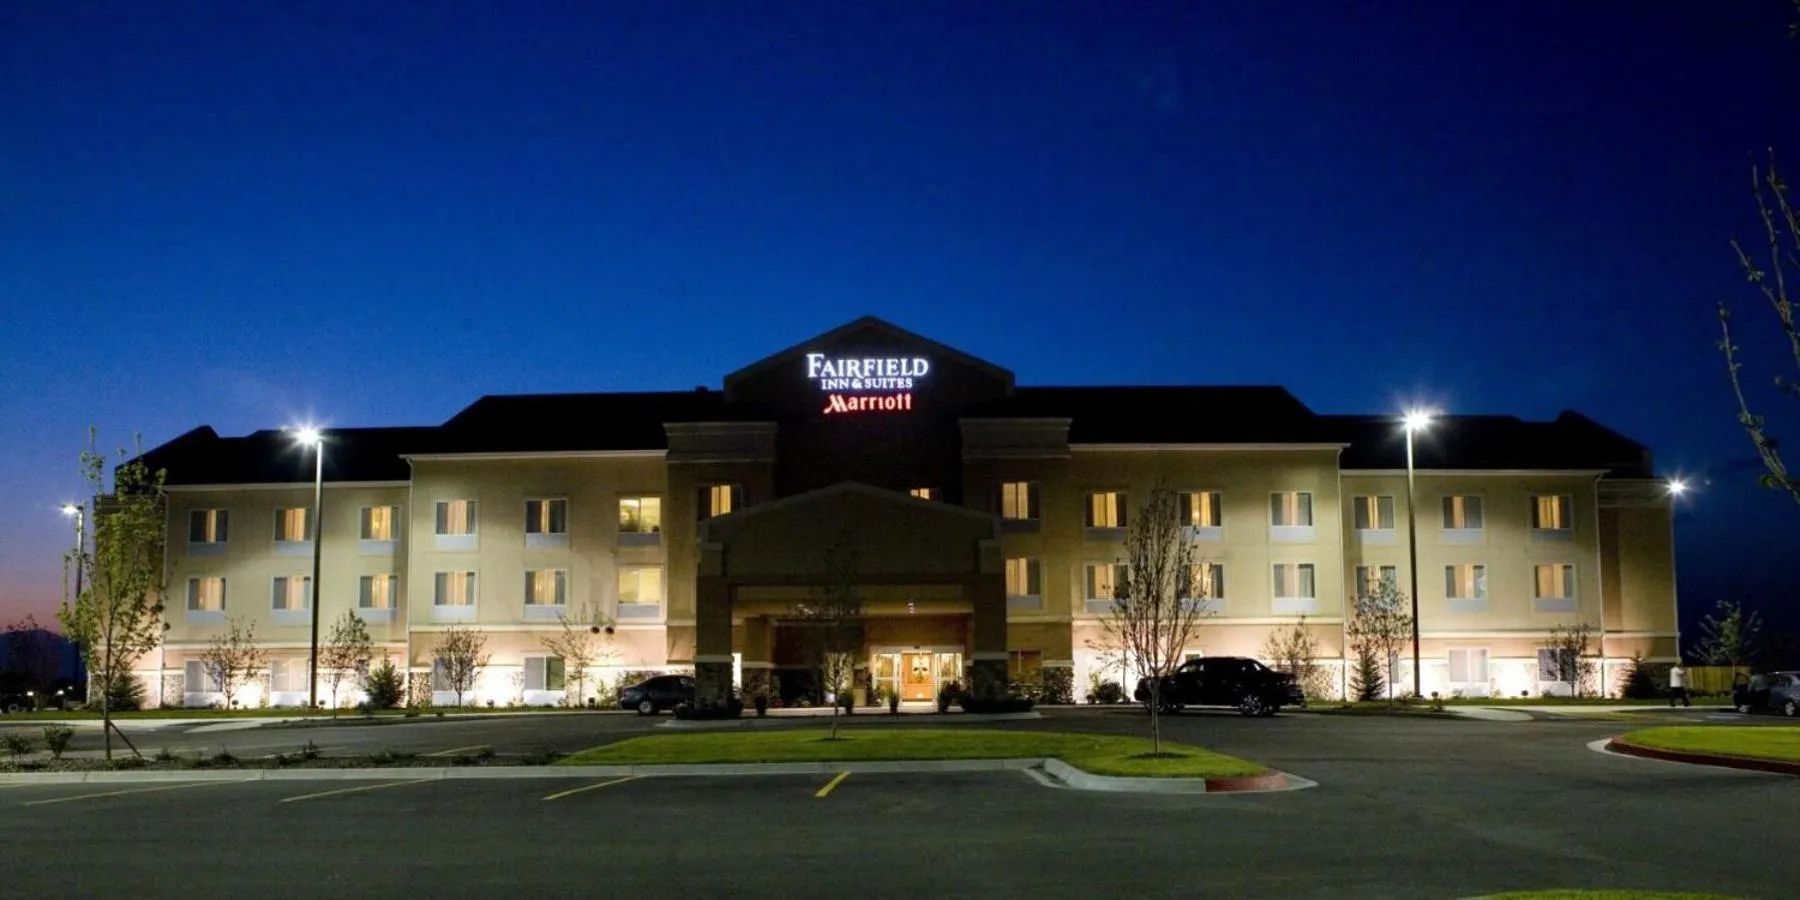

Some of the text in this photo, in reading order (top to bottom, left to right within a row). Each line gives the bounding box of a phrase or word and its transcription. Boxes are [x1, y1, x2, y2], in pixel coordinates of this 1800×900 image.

[806, 353, 929, 379] FAIRFIELD
[821, 377, 913, 390] INN & SUITES
[823, 393, 911, 414] Marriott
